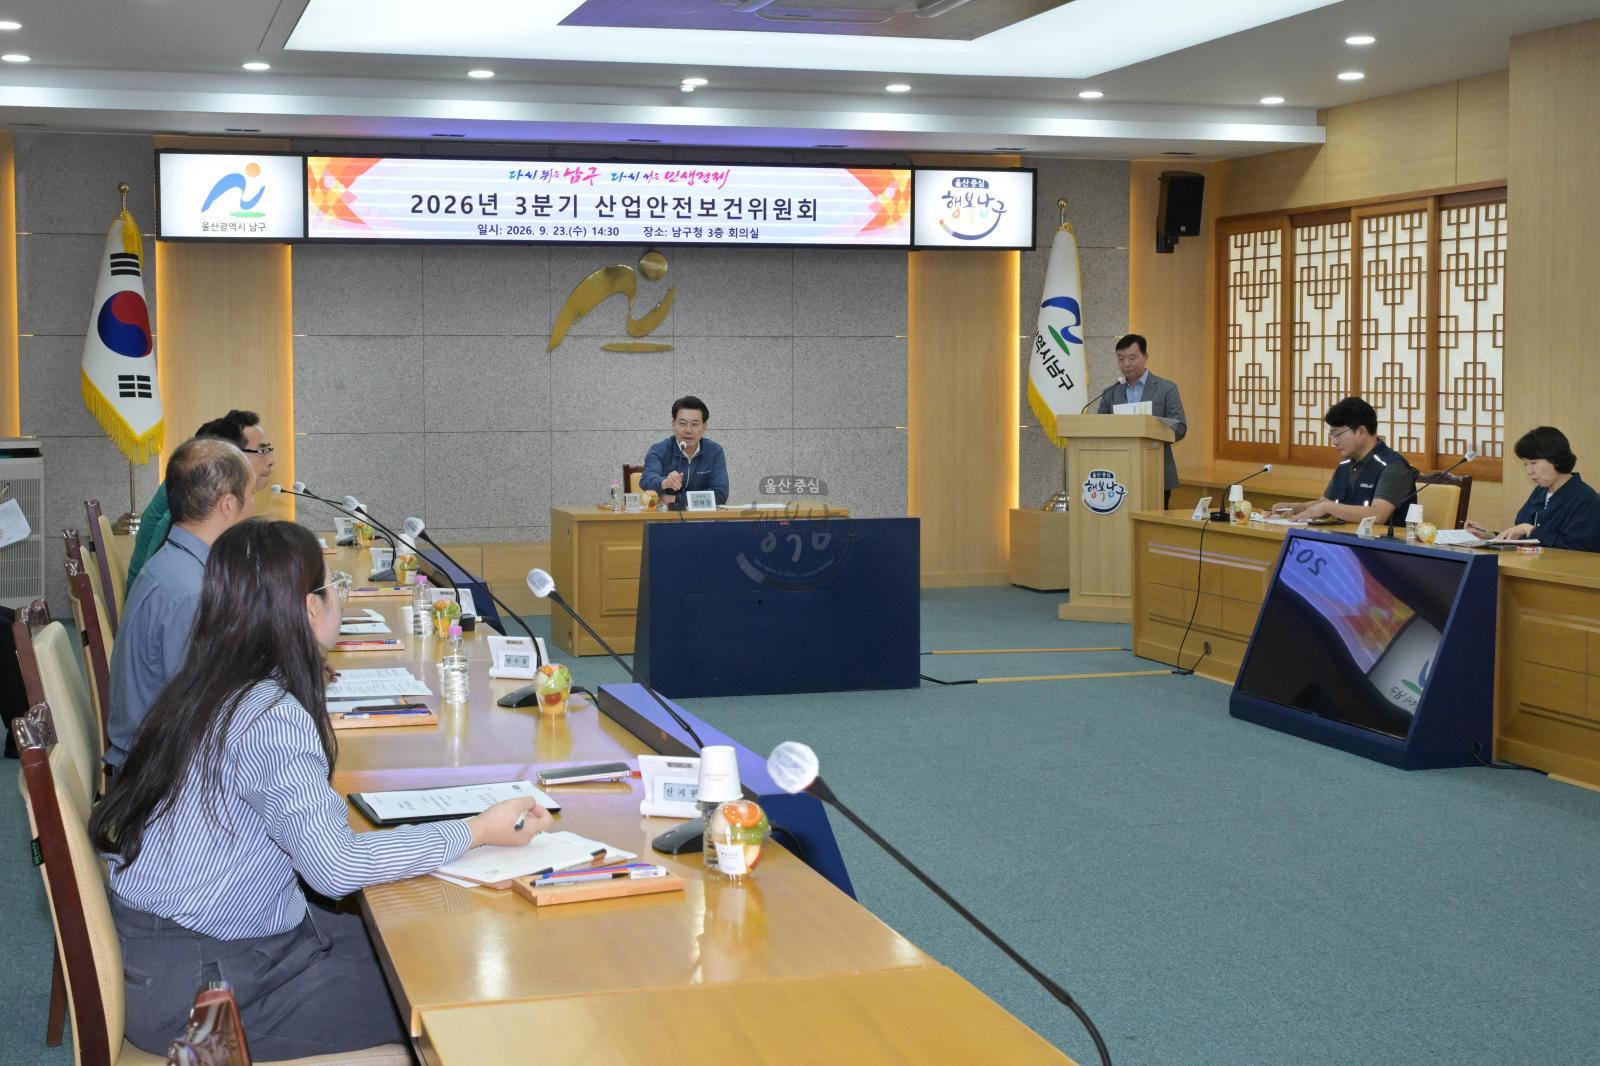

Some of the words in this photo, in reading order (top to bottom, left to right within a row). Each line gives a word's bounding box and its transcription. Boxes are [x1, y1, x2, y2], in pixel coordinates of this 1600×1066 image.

[508, 169, 538, 181] 다시
[563, 166, 601, 186] 남구
[610, 171, 640, 182] 다시
[664, 169, 730, 190] 민생경제
[410, 192, 499, 217] 2026년
[514, 194, 578, 218] 3분기
[595, 195, 818, 222] 산업안전보건위원회
[201, 221, 246, 233] 울산광역시
[249, 222, 267, 233] 남구
[477, 223, 503, 236] 일시:
[506, 225, 535, 237] 2026.
[539, 226, 549, 237] 9.
[552, 225, 587, 238] 23.(수)
[592, 226, 620, 238] 14:30
[643, 226, 668, 238] 장소:
[672, 226, 703, 239] 남구청
[707, 227, 724, 239] 3층
[728, 227, 760, 240] 회의실
